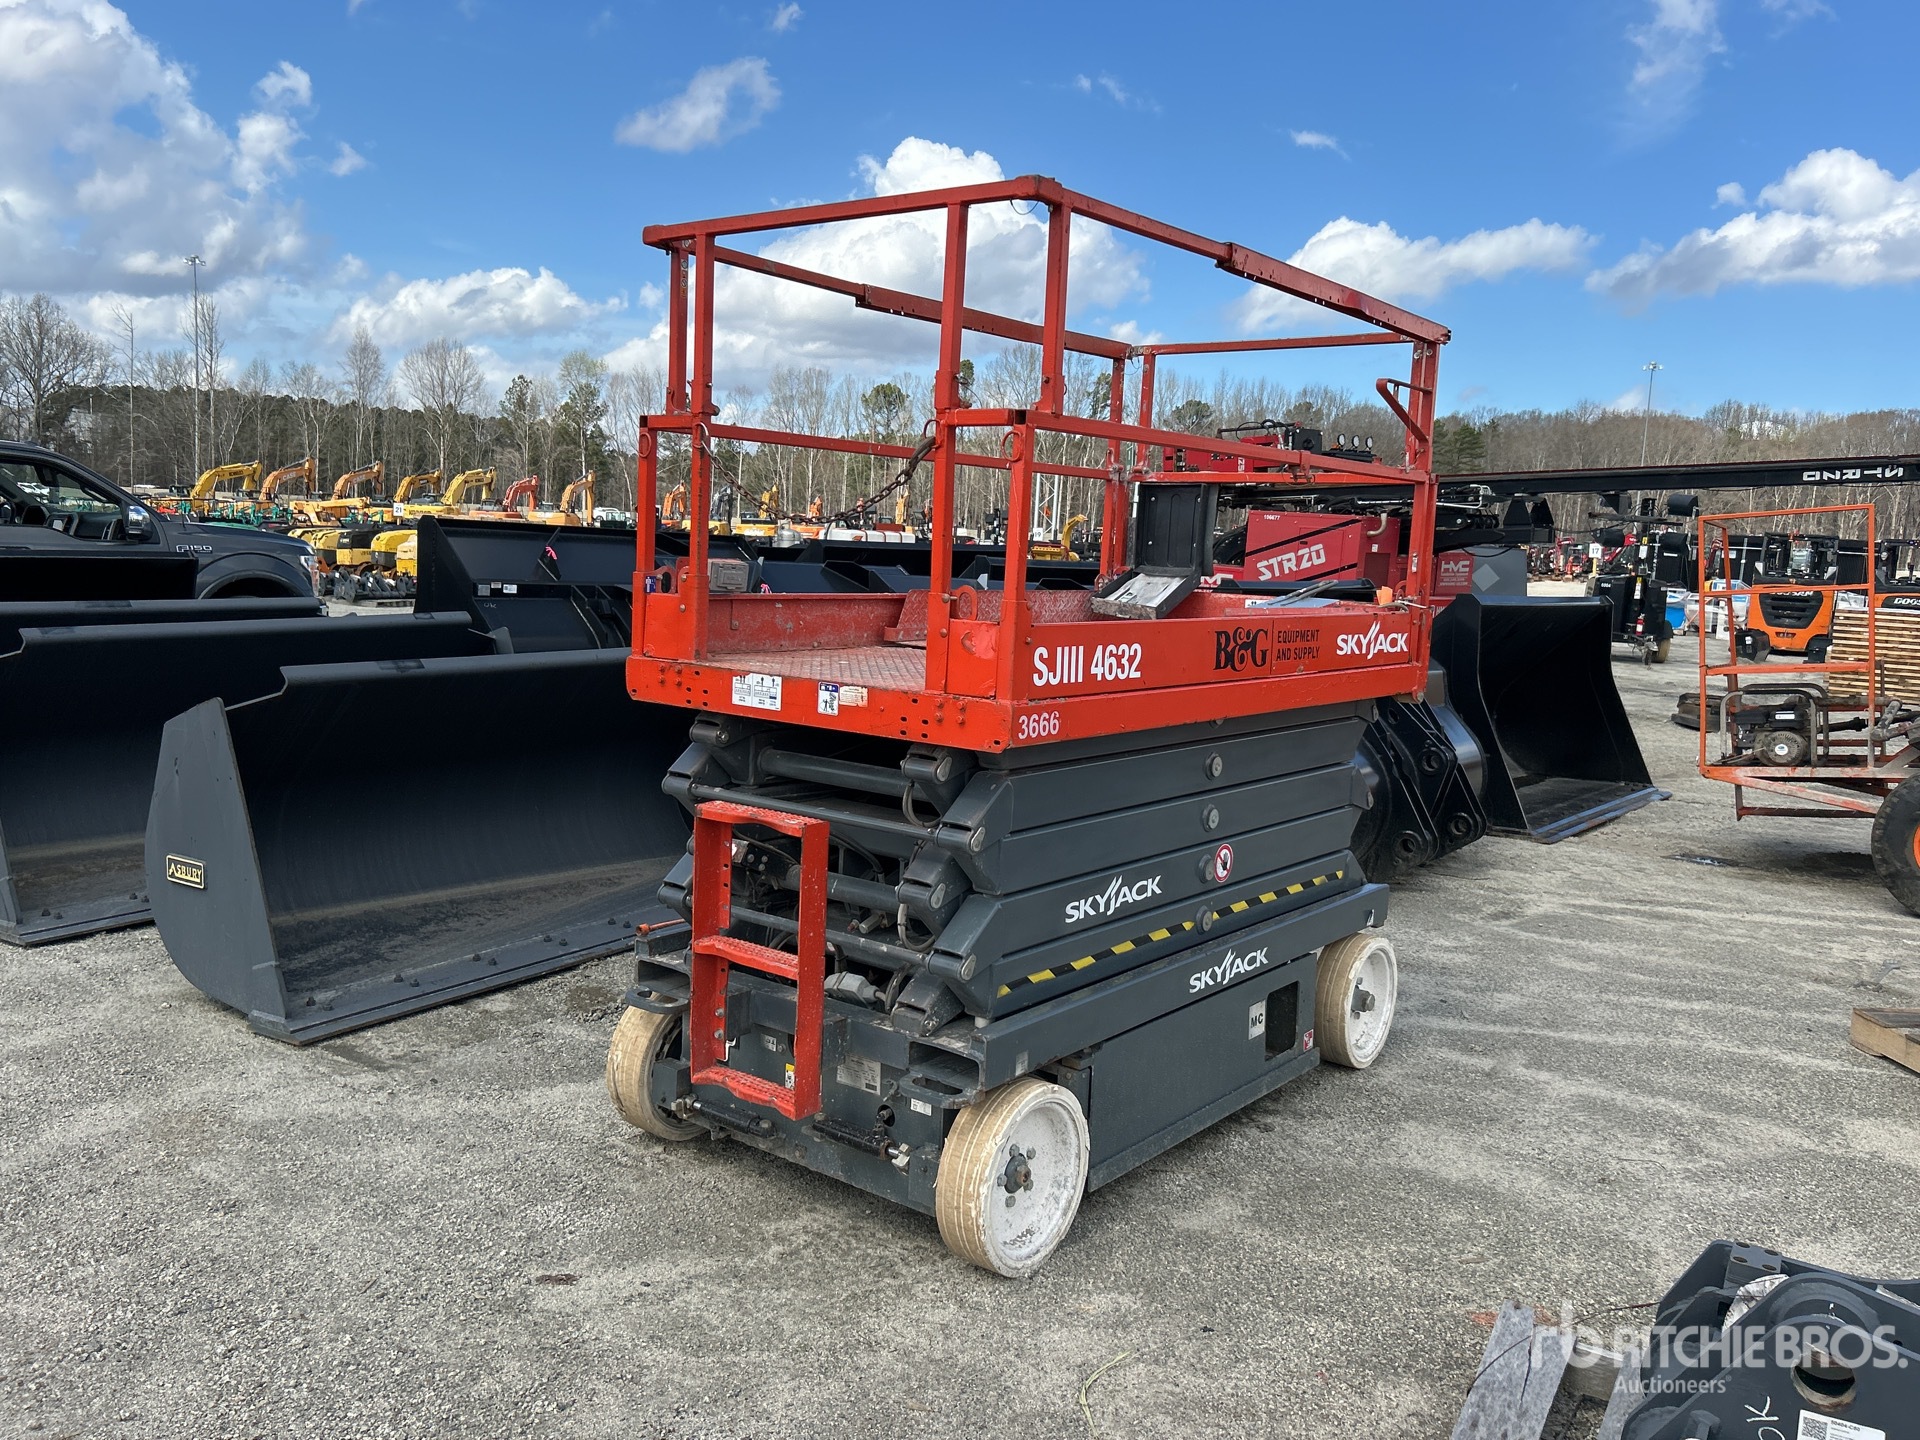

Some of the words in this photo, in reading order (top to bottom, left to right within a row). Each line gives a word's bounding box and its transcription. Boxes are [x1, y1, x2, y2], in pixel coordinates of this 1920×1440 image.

[282, 471, 296, 481] CASE
[1256, 543, 1326, 582] STR20
[1591, 547, 1600, 555] 17
[1441, 560, 1470, 572] HMC
[1277, 629, 1320, 644] EQUIPMENT
[1336, 620, 1409, 660] SKYJACK
[1213, 626, 1269, 673] B&G
[1276, 648, 1292, 661] AND
[1294, 646, 1320, 660] SUPPLY
[1033, 645, 1084, 687] SJIII
[1090, 642, 1142, 681] 4632
[1018, 710, 1060, 740] 3666
[169, 862, 202, 883] ASBURY
[1064, 874, 1163, 924] SKYJACK
[1189, 946, 1269, 994] SKYJACK
[1250, 1012, 1264, 1029] MC
